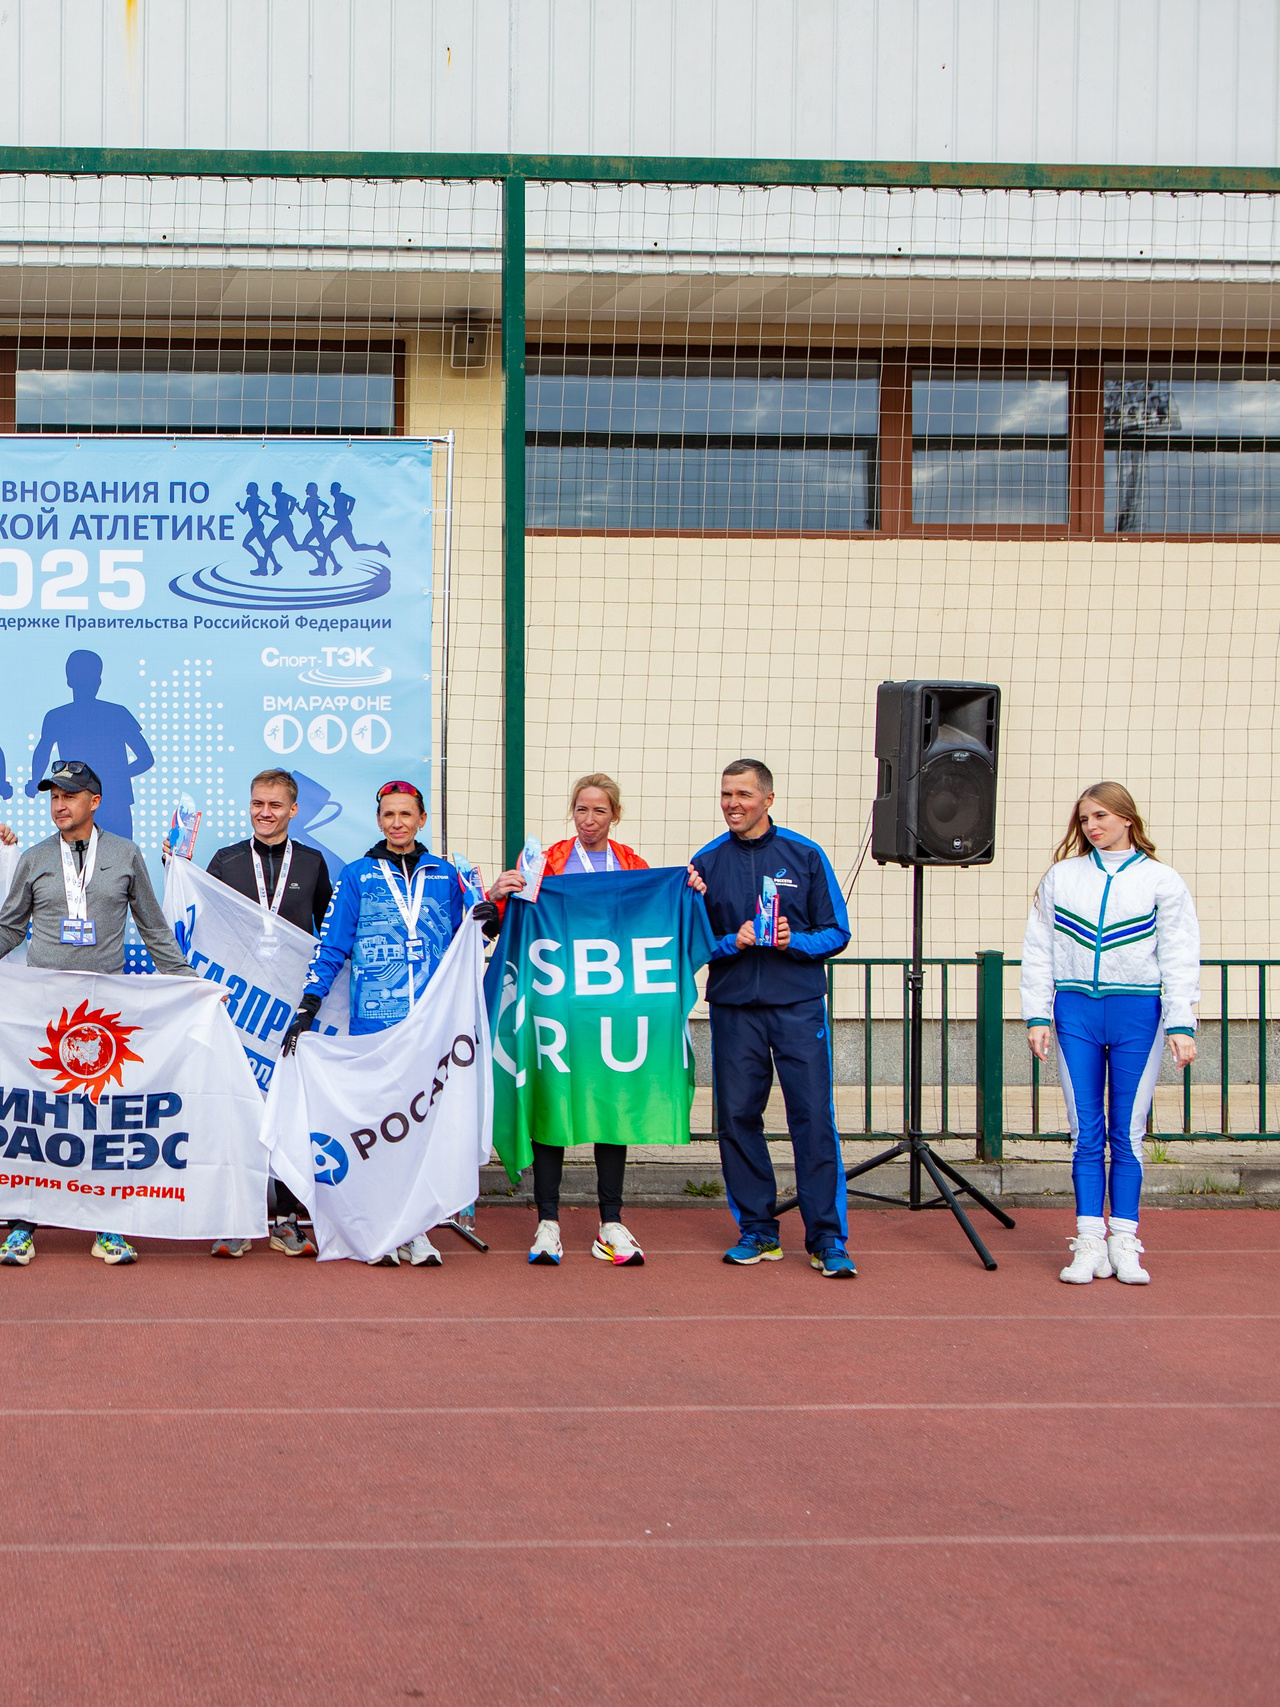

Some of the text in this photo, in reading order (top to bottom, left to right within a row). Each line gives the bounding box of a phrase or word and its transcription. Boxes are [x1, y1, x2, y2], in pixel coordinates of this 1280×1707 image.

[169, 481, 210, 504] ПО
[69, 513, 235, 541] АТЛЕТИКЕ
[65, 614, 188, 631] Правительства
[193, 614, 290, 630] Российской
[294, 615, 392, 632] Федерации
[263, 695, 392, 712] ВМАРАФОНЕ
[533, 1015, 689, 1073] RU
[350, 1025, 481, 1160] РОСАТО
[66, 1179, 106, 1196] без
[110, 1184, 186, 1202] границ
